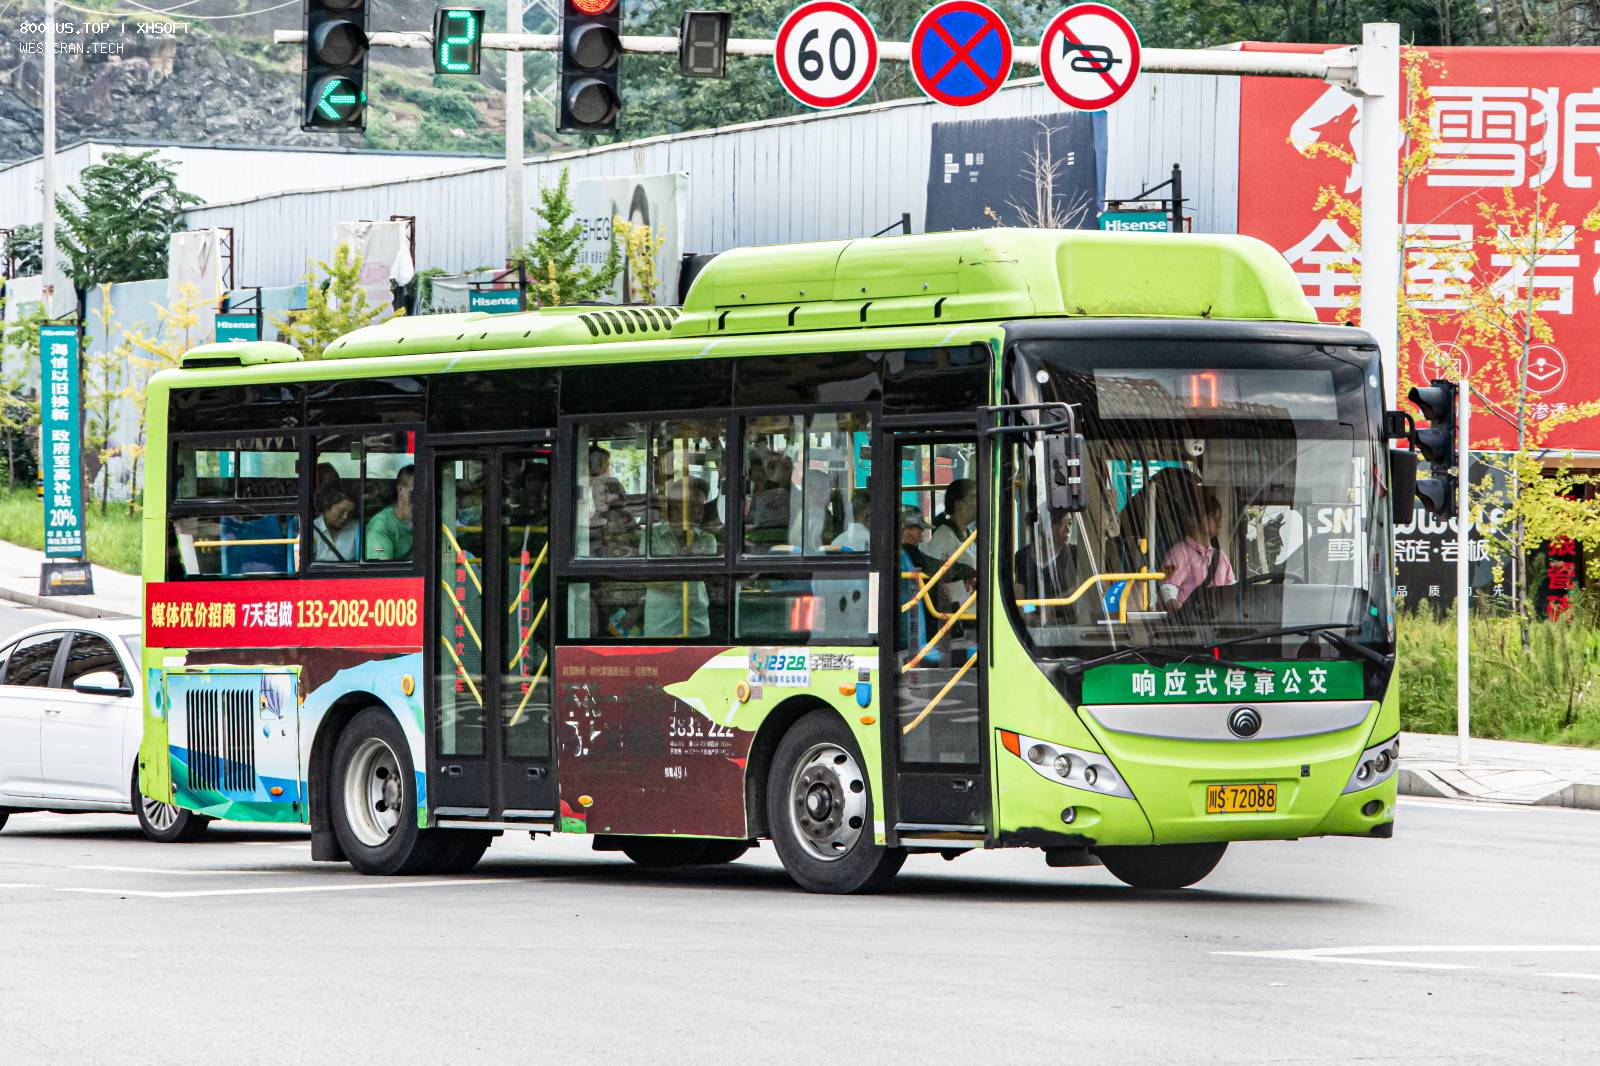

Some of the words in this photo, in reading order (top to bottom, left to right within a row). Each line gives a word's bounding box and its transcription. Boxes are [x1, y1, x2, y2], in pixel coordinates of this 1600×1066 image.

[440, 10, 475, 71] 2
[797, 28, 857, 81] 60
[1105, 219, 1166, 232] Hisense
[472, 296, 519, 307] Hisense
[217, 321, 257, 330] Hisense
[50, 343, 69, 421] 海信以旧换新
[1190, 372, 1217, 408] 17
[50, 508, 77, 527] 20%
[151, 602, 236, 628] 媒体优价招商
[241, 602, 293, 628] 7天起做
[296, 598, 418, 628] 133-2082-0008
[1131, 666, 1329, 697] 响应式停靠公交
